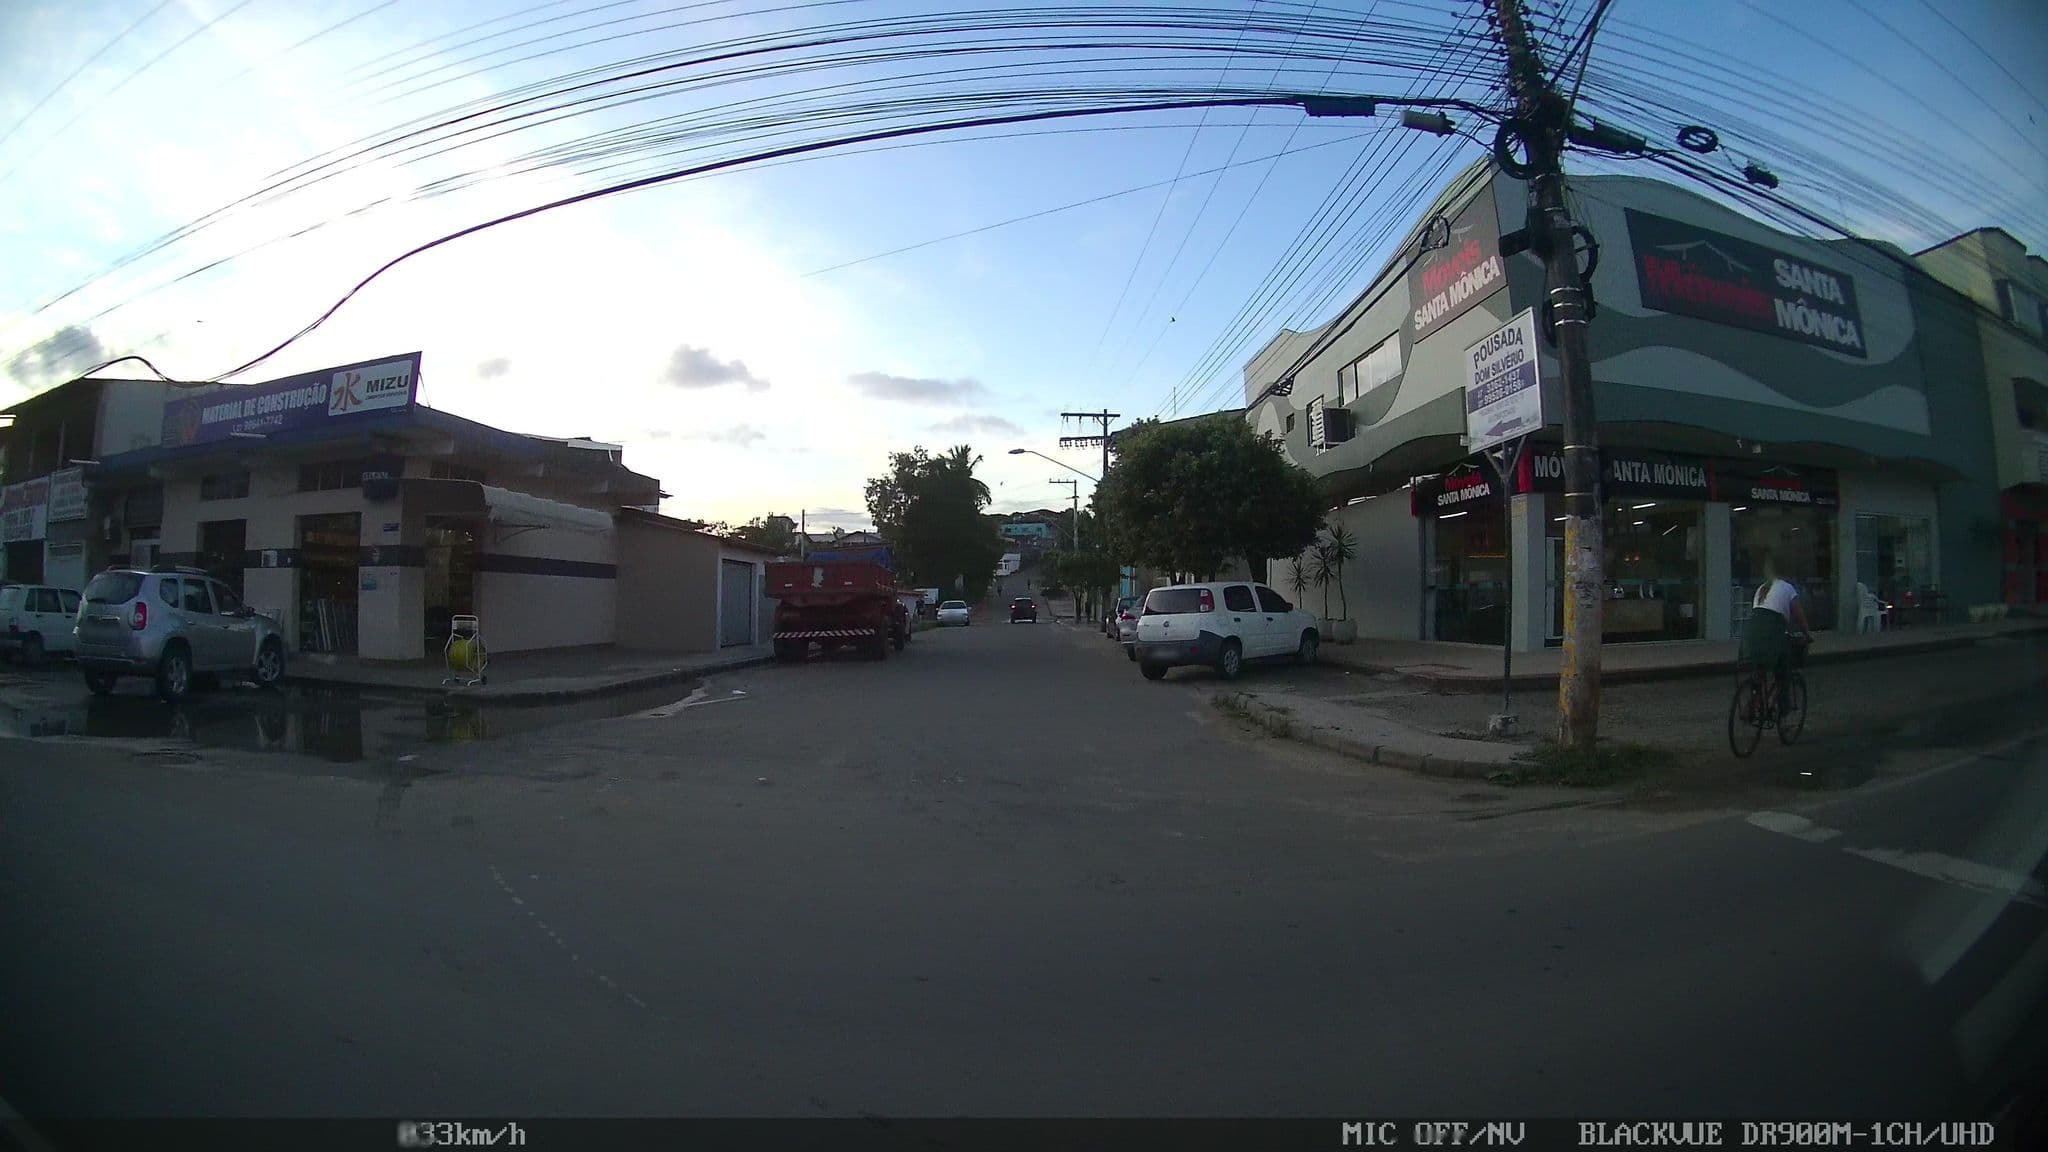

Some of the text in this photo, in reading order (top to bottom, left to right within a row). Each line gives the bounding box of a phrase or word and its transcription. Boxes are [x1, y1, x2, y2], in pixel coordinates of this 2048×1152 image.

[1414, 256, 1500, 331] SANTA MÔNICA
[1773, 258, 1845, 305] SANTA
[1774, 297, 1862, 349] MÔNICA
[1473, 328, 1523, 369] POUSADA
[1474, 349, 1525, 385] DOM SILVÉRIO
[203, 401, 242, 424] MATERIAL
[244, 397, 256, 417] DE
[258, 382, 327, 411] CONSTRUÇÃO
[366, 375, 409, 393] MIZU
[1613, 460, 1651, 484] ANTA
[1437, 482, 1490, 507] SANTA MÔNICA
[1751, 487, 1778, 501] SANTA
